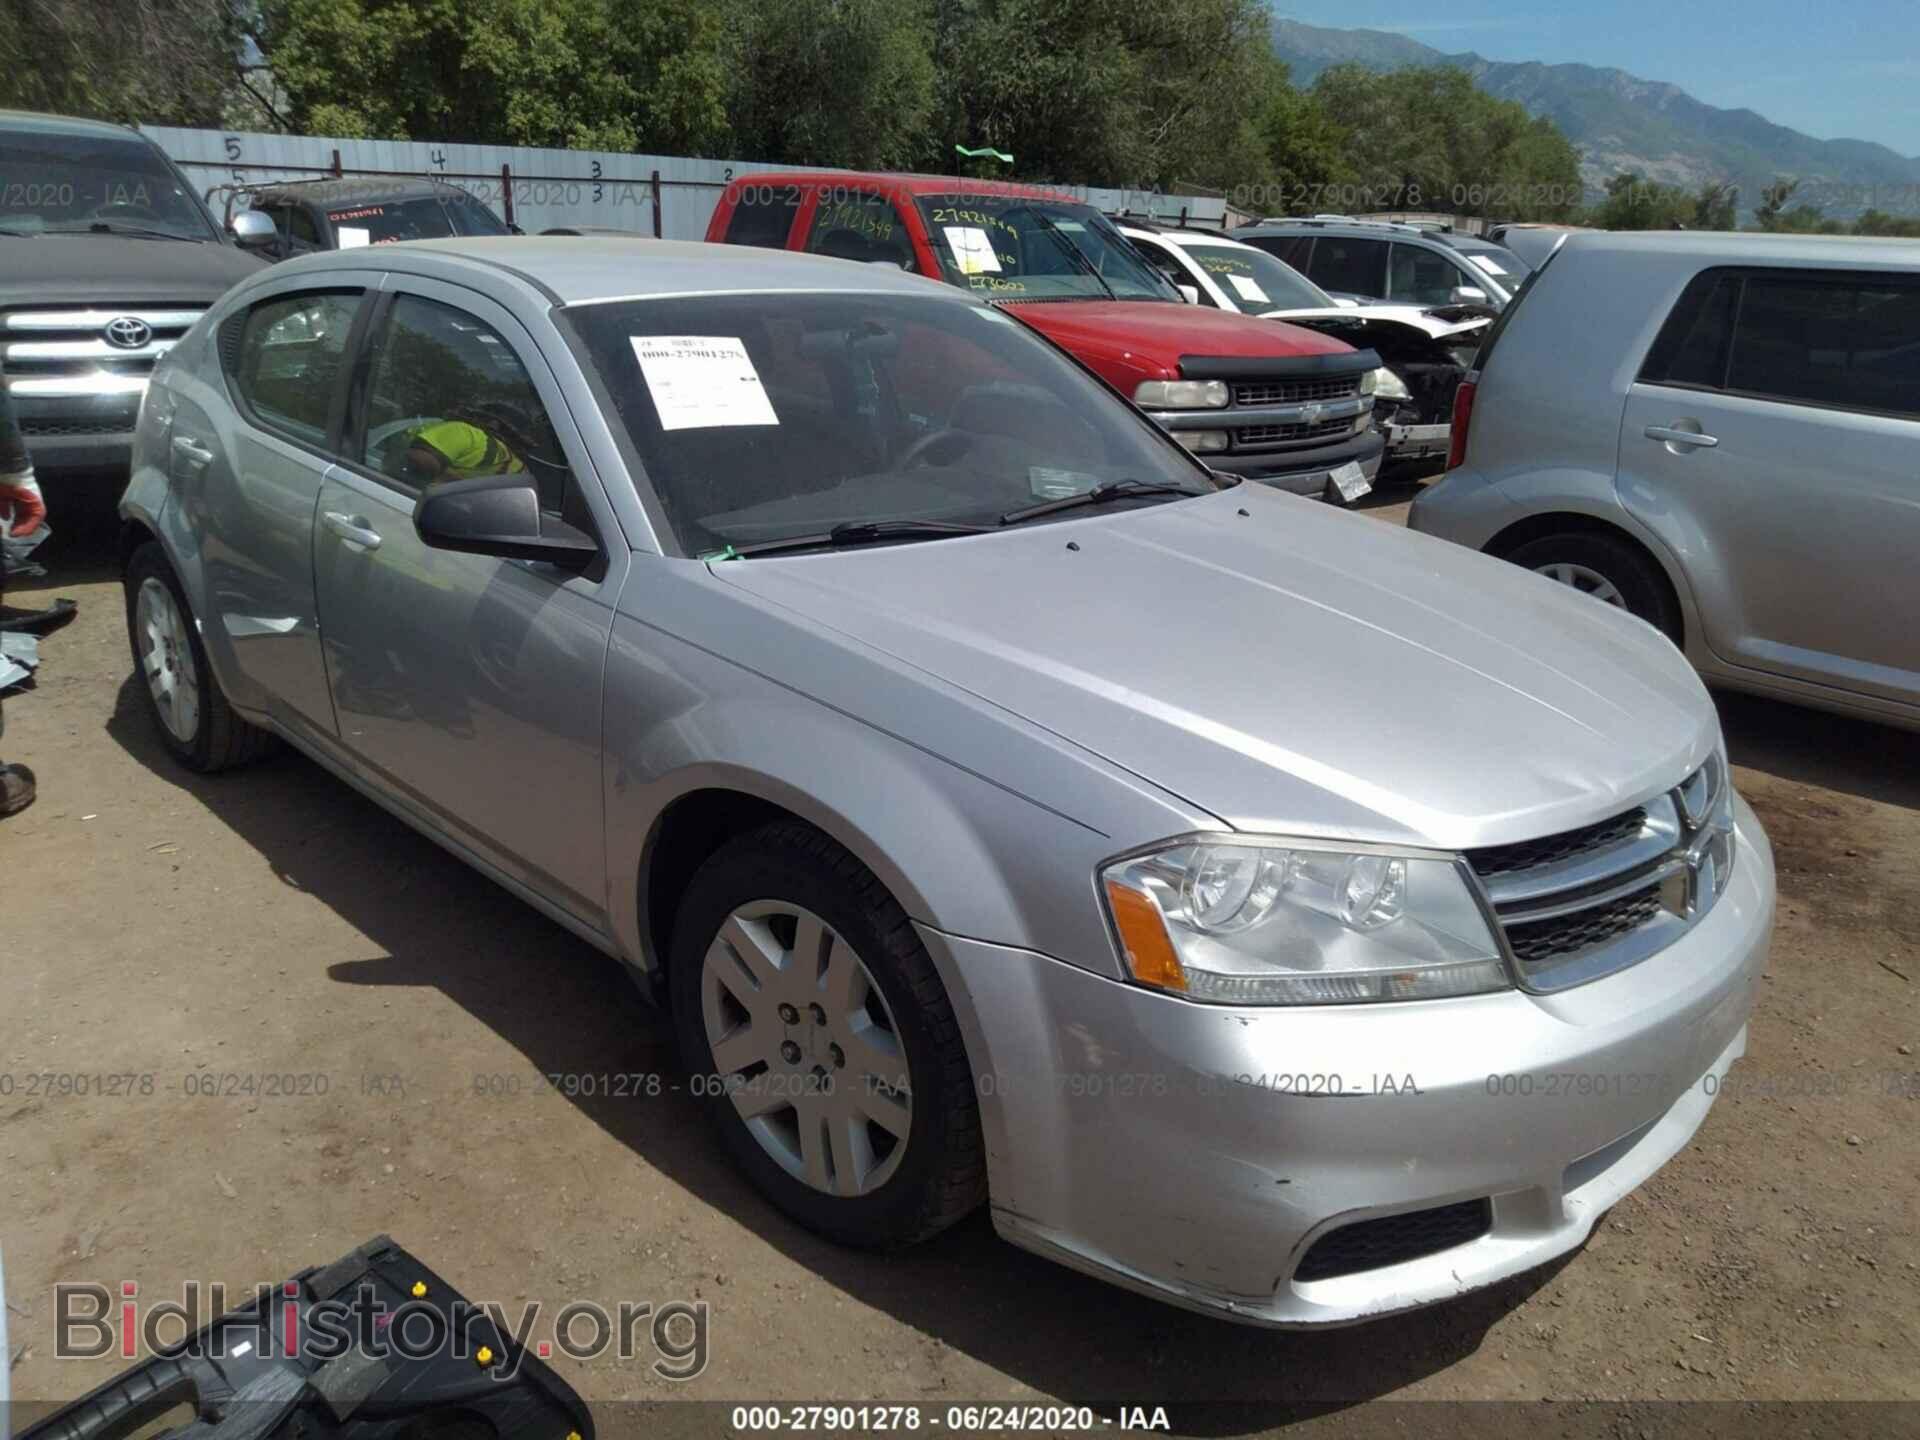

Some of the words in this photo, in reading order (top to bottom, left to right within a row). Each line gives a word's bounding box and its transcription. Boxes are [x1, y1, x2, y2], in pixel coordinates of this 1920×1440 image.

[224, 137, 242, 161] 5
[431, 149, 446, 171] 4
[591, 161, 602, 178] 3
[724, 168, 733, 181] 2
[592, 183, 603, 202] 3
